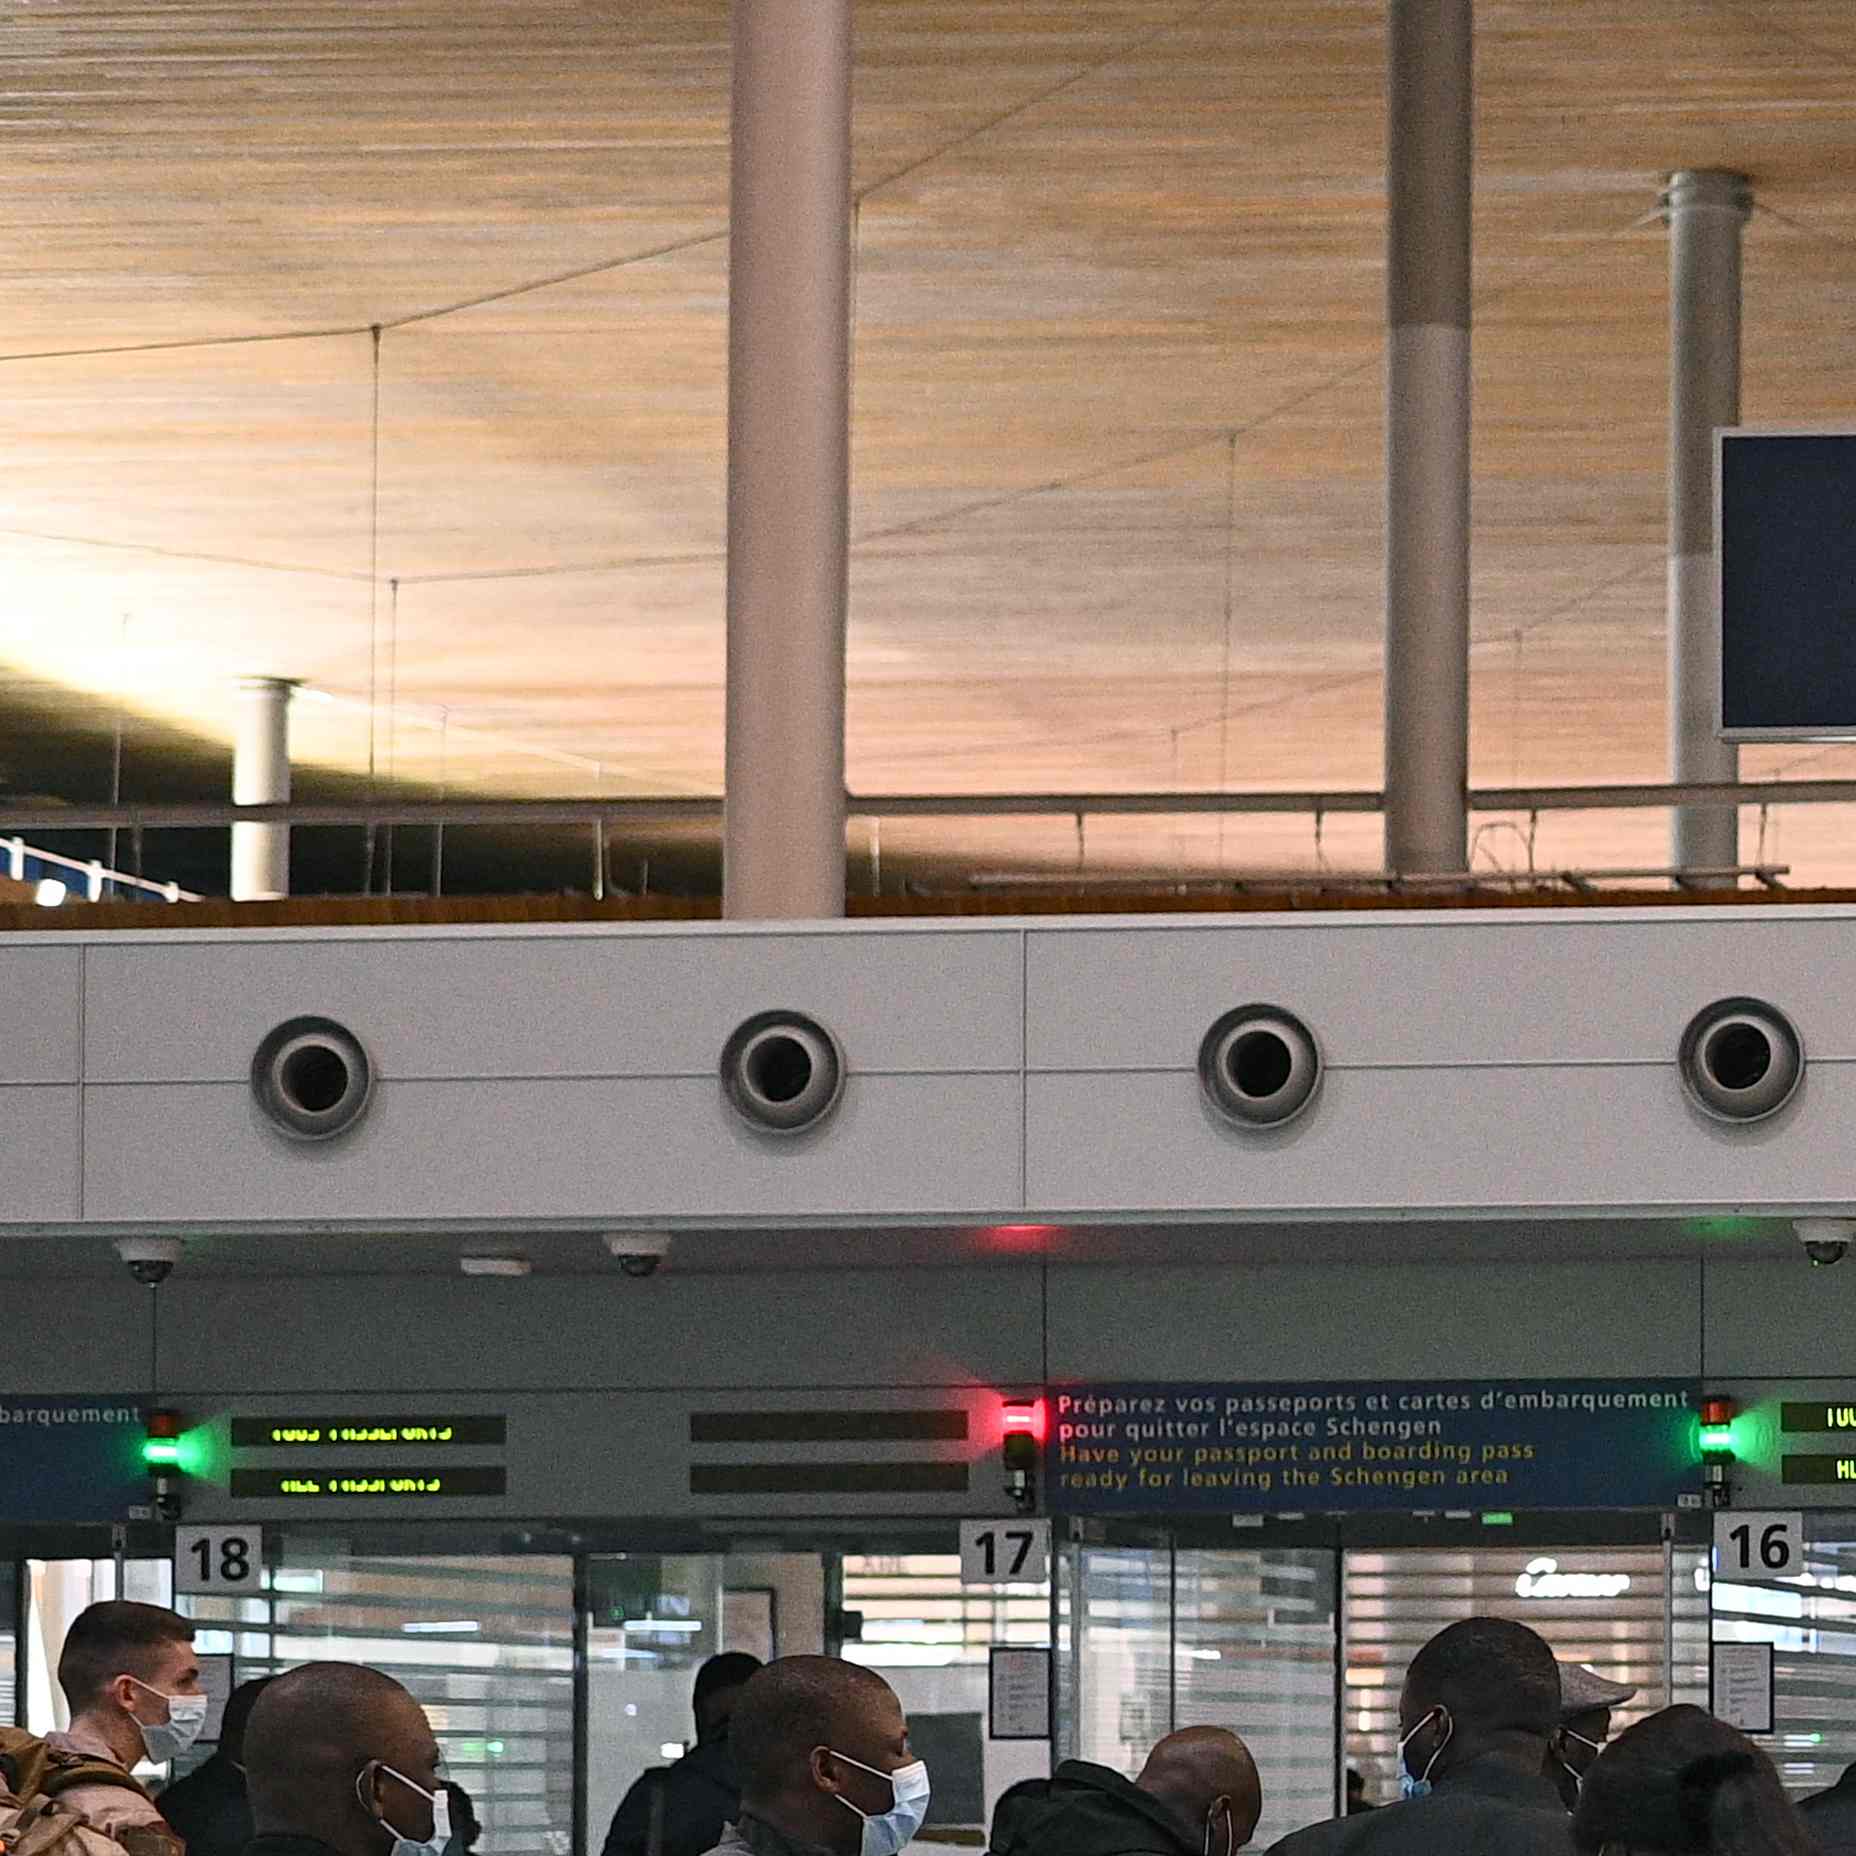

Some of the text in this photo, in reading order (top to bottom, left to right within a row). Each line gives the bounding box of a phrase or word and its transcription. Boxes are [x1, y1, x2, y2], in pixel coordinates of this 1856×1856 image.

[1058, 1393, 1165, 1415] Préparez
[1176, 1396, 1216, 1411] vos
[1226, 1393, 1355, 1414] passeports
[1365, 1393, 1389, 1409] et
[1399, 1392, 1470, 1409] cartes
[1060, 1422, 1115, 1440] pour
[1126, 1418, 1209, 1439] quitter
[1327, 1417, 1442, 1438] Schengen
[1060, 1441, 1535, 1464] Have your passport and boarding pass
[1060, 1466, 1509, 1490] ready for leaving the Schengen area
[976, 1531, 1033, 1575] 17
[1730, 1524, 1789, 1569] 16
[191, 1538, 249, 1581] 18
